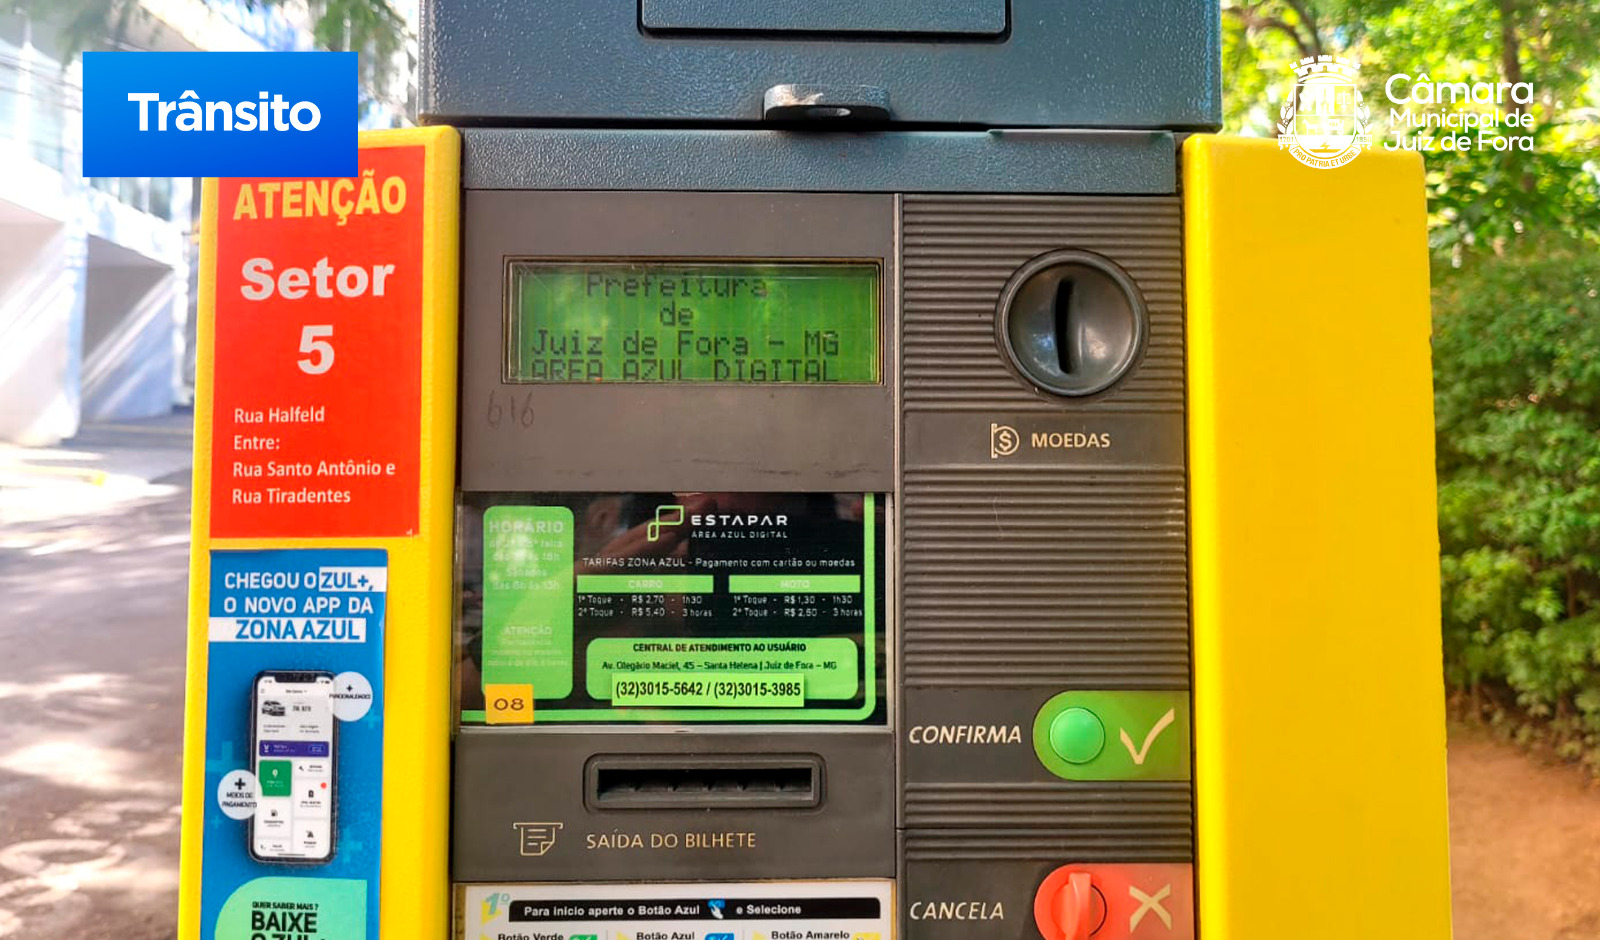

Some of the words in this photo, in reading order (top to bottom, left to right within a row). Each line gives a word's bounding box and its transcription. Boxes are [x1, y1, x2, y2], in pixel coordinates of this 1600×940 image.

[233, 169, 406, 226] ATENÇÃO
[240, 256, 395, 301] Setor
[586, 274, 767, 298] Prefeitura
[660, 301, 694, 326] de
[297, 324, 335, 375] 5
[532, 331, 603, 355] Juiz
[624, 331, 658, 355] de
[678, 331, 749, 355] Fora
[805, 331, 839, 355] MG
[233, 407, 264, 424] Rua
[268, 406, 325, 423] Halfeld
[233, 435, 280, 451] Entre:
[1032, 432, 1110, 448] MOEDAS
[233, 461, 264, 477] Rua
[267, 461, 313, 477] Santo
[317, 459, 381, 476] Antônio
[386, 464, 395, 475] e
[232, 488, 262, 504] Rua
[267, 488, 351, 504] Tiradentes
[489, 518, 563, 533] HORÁRIO
[692, 515, 788, 526] ESTAPAR
[692, 530, 717, 538] ÁREA
[582, 558, 625, 567] TARIFAS
[628, 558, 656, 567] ZONA
[659, 558, 685, 567] AZUL
[695, 558, 749, 569] Pagamento
[751, 559, 770, 567] com
[773, 557, 804, 567] cartão
[806, 559, 817, 567] ou
[820, 558, 855, 567] moedas
[225, 572, 300, 589] CHEGOU
[304, 572, 316, 588] O
[321, 571, 374, 591] ZUL+,
[628, 580, 662, 589] CARRO
[224, 597, 236, 613] O
[244, 597, 297, 613] NOVO
[303, 597, 341, 613] APP
[348, 596, 373, 613] DA
[589, 596, 611, 605] Toque
[632, 595, 644, 604] R$
[682, 596, 702, 604] 1h30
[743, 596, 768, 605] Toque
[784, 596, 796, 605] R$
[797, 596, 815, 604] 1,30
[833, 596, 853, 604] 1h30
[590, 608, 613, 617] Toque
[632, 608, 644, 616] R$
[645, 608, 665, 617] 5,40
[744, 608, 768, 617] Toque
[784, 608, 796, 617] R$
[236, 620, 297, 639] ZONA
[301, 619, 360, 639] AZUL
[633, 643, 673, 652] CENTRAL
[676, 643, 687, 651] DE
[688, 643, 751, 652] ATENDIMENTO
[753, 643, 765, 652] AO
[767, 642, 806, 652] USUÁRIO
[602, 661, 615, 669] Av.
[704, 661, 728, 669] Santa
[730, 661, 758, 669] Helena
[764, 661, 781, 669] Juiz
[783, 661, 794, 669] de
[796, 661, 814, 669] Fora
[823, 661, 837, 669] MG
[616, 681, 702, 698] (32)3015-5642
[714, 681, 801, 697] (32)3015-3985
[494, 698, 524, 711] 08
[909, 725, 1022, 744] CONFIRMA
[587, 829, 643, 848] SAÍDA
[651, 833, 677, 848] DO
[685, 833, 756, 848] BILHETE
[252, 901, 271, 909] QUER
[272, 902, 295, 910] SABER
[524, 906, 549, 917] Para
[588, 906, 623, 918] aperte
[638, 905, 671, 916] Botão
[674, 905, 700, 915] Azul
[736, 906, 743, 915] e
[746, 904, 801, 915] Selecione
[910, 902, 1004, 920] CANCELA
[252, 911, 317, 933] BAIXE
[636, 931, 669, 940] Botão
[673, 931, 695, 940] Azul
[772, 930, 802, 940] Botão
[806, 930, 851, 940] Amarelo
